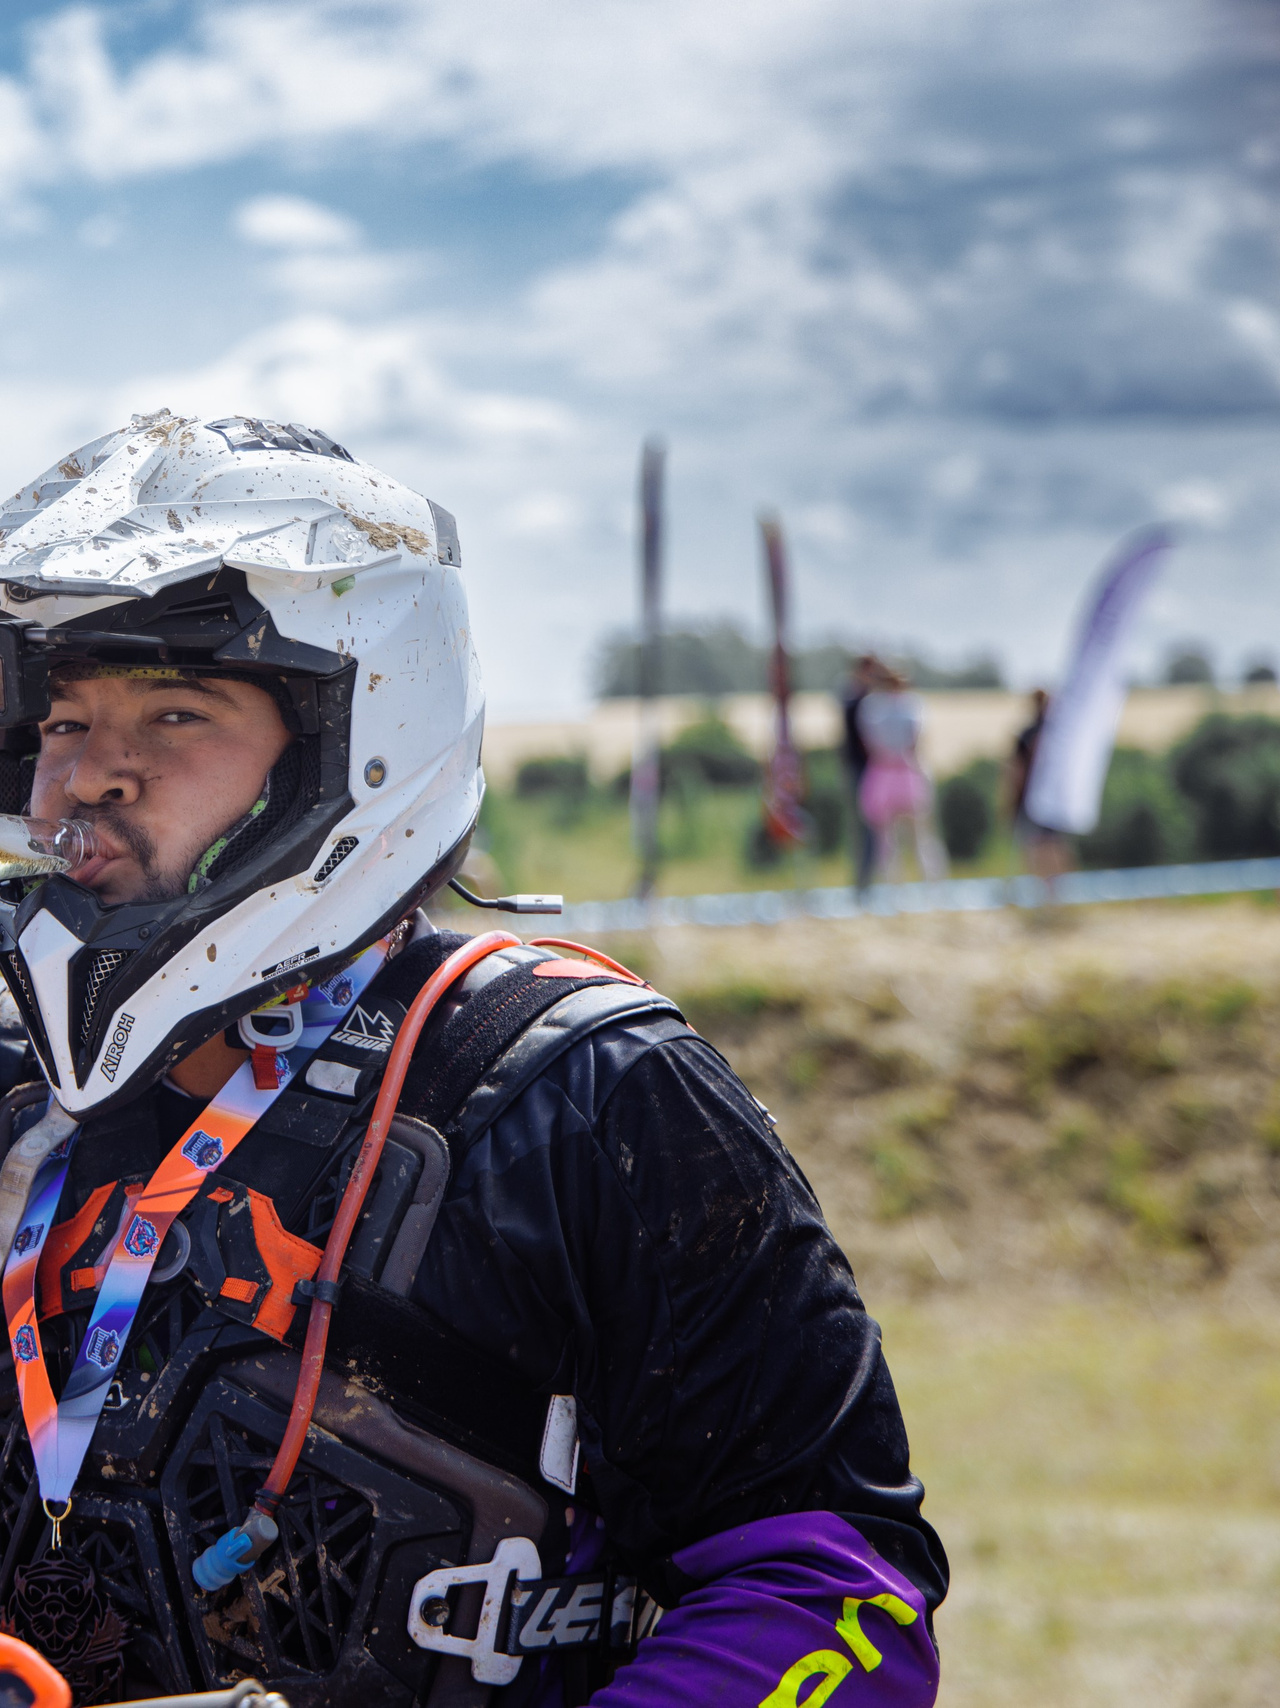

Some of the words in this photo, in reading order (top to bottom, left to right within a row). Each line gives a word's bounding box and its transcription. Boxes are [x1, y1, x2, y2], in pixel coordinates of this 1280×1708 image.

[263, 961, 302, 981] EMERGENCY
[303, 953, 320, 964] ONLY
[100, 1012, 136, 1082] AIROH
[330, 1030, 392, 1052] USWE
